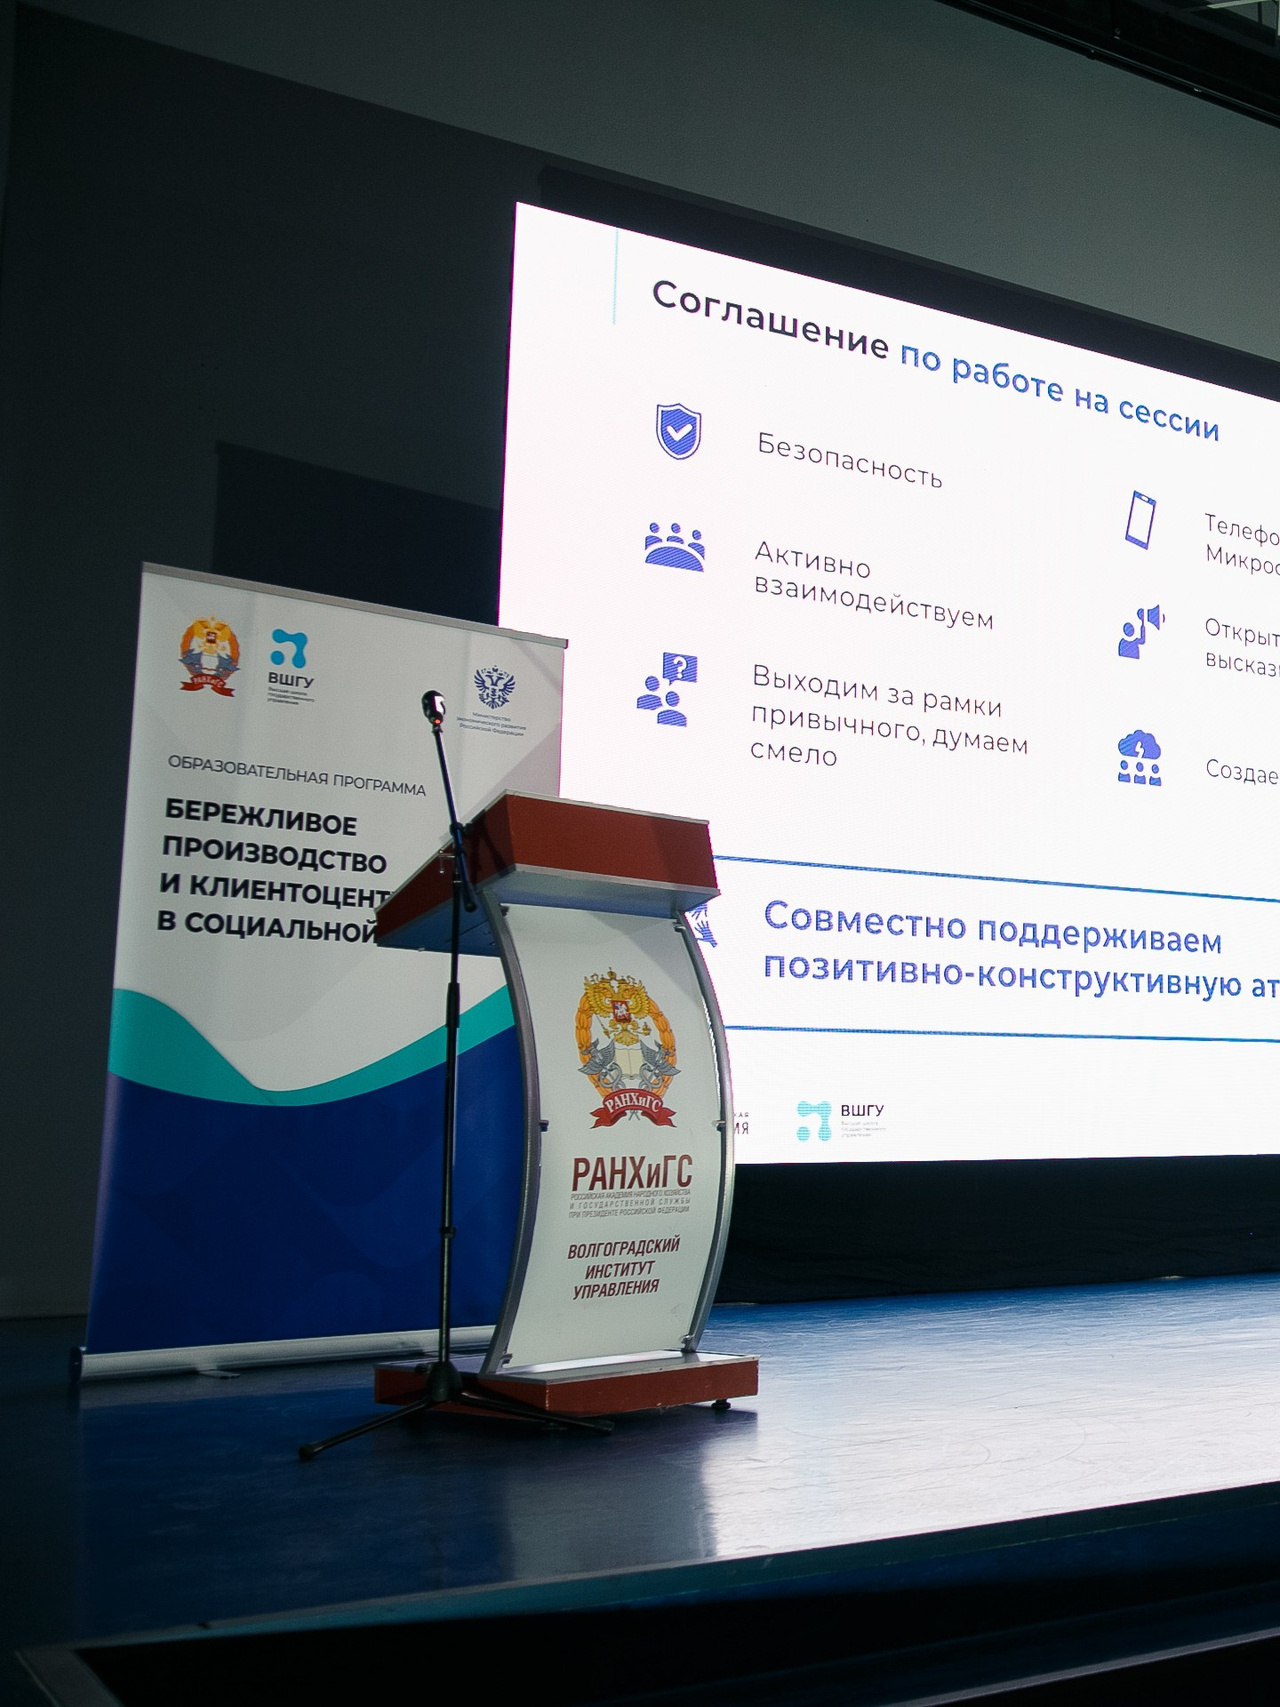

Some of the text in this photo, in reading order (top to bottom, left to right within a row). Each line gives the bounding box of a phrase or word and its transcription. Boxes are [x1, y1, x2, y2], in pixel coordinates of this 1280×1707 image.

[653, 280, 1220, 441] Соглашение по работе на сессии
[759, 432, 942, 488] Безопасность
[755, 541, 871, 578] Активно
[755, 576, 993, 630] взаимодействуем
[268, 672, 315, 688] ВШГУ
[753, 664, 1002, 718] Выходим за рамки
[752, 706, 1028, 755] привычного, думаем
[751, 742, 837, 766] смело
[168, 755, 427, 797] ОБРАЗОВАТЕЛЬНАЯ ПРОГРАММА
[165, 798, 357, 836] БЕРЕЖЛИВОЕ
[162, 835, 387, 874] ПРОИЗВОДСТВО
[160, 873, 396, 909] И КЛИЕНТОЦЕНТ
[157, 910, 377, 944] В СОЦИАЛЬНОЙ
[765, 900, 1222, 953] Совместно поддерживаем
[765, 955, 1242, 1002] позитивно-конструктивную
[605, 1092, 662, 1113] РАНХиГС
[841, 1104, 884, 1117] ВШГУ
[572, 1154, 693, 1191] РАНХиГС
[570, 1191, 605, 1201] РОССИЙСКАЯ
[606, 1191, 632, 1199] АКАДЕМИЯ
[633, 1189, 663, 1198] НАРОДНОГО
[578, 1199, 655, 1209] ГОСУДАРСТВЕННОЙ
[659, 1198, 690, 1206] СЛУЖБЫ
[582, 1209, 618, 1218] ПРЕЗИДЕНТЕ
[620, 1207, 656, 1216] РОССИЙСКОЙ
[658, 1206, 690, 1214] ФЕДЕРАЦИИ
[568, 1234, 680, 1259] ВОЛГОГРАДСКИЙ
[585, 1260, 655, 1279] ИНСТИТУТ
[573, 1279, 660, 1300] УПРАВЛЕНИЯ
